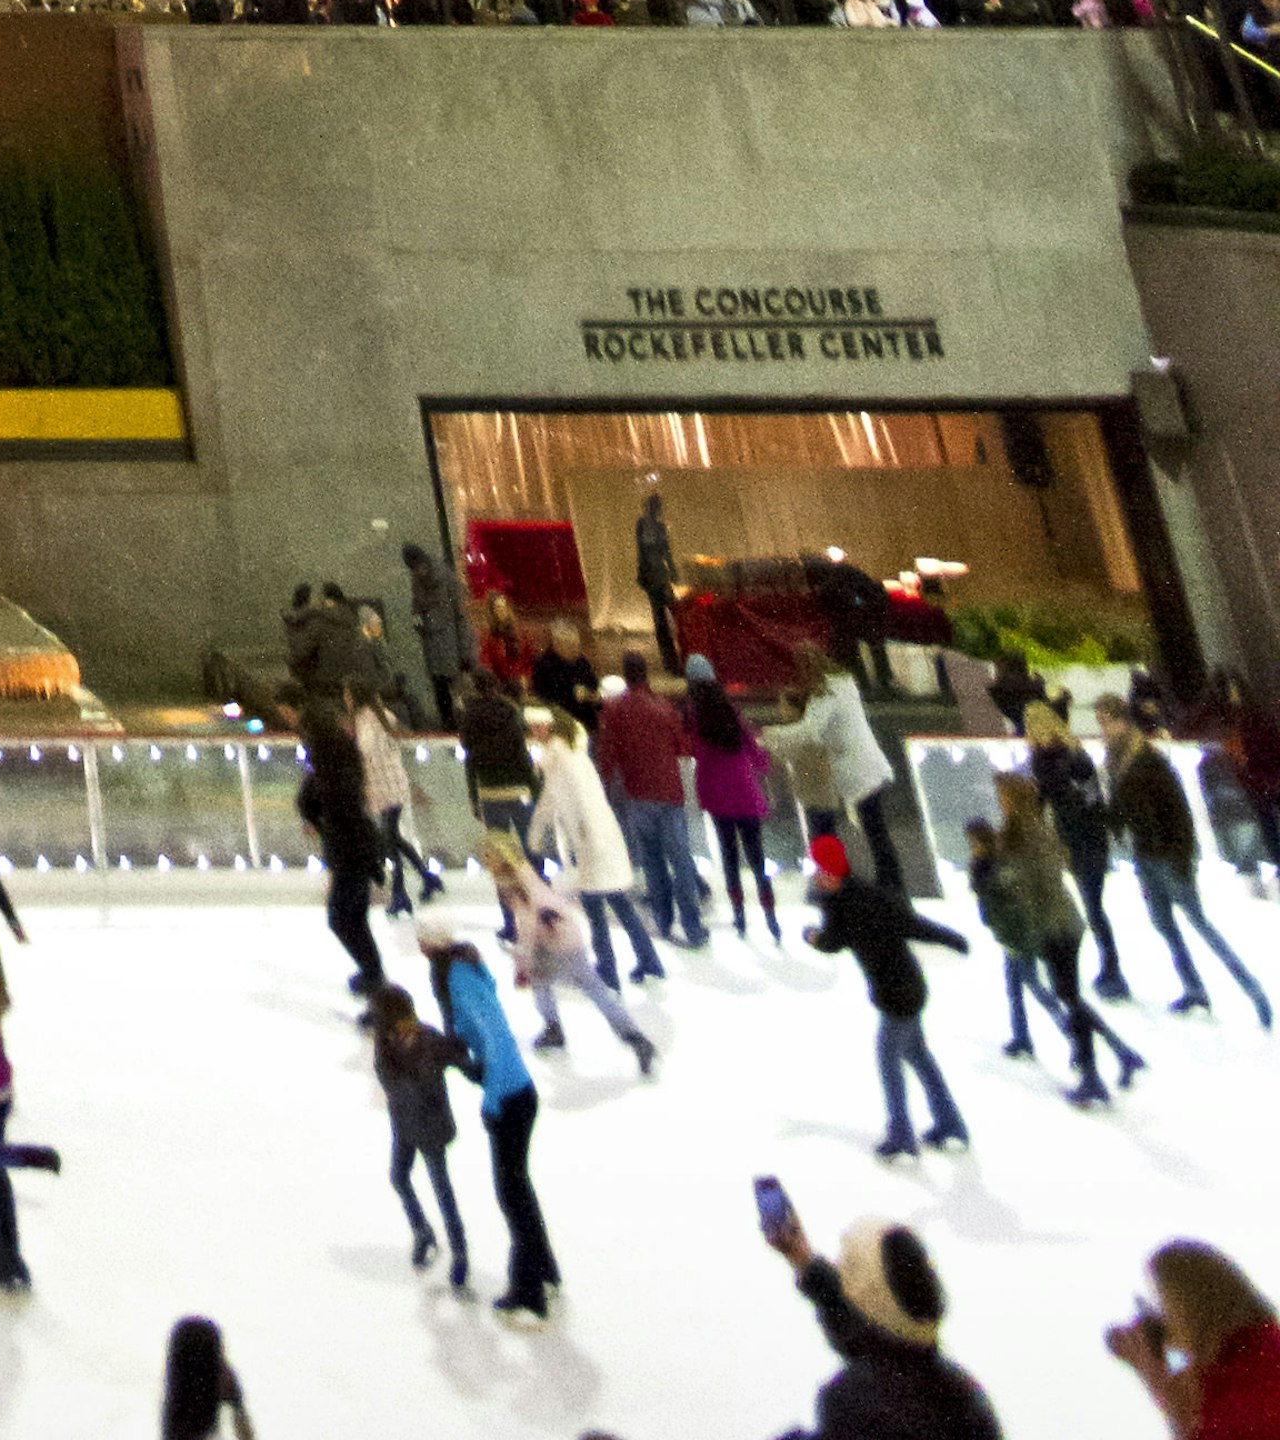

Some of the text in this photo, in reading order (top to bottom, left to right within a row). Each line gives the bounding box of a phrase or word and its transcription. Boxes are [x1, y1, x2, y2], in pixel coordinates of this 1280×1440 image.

[627, 286, 884, 318] THE CONCOURSE
[583, 330, 945, 362] ROCKEFELLER CENTER
